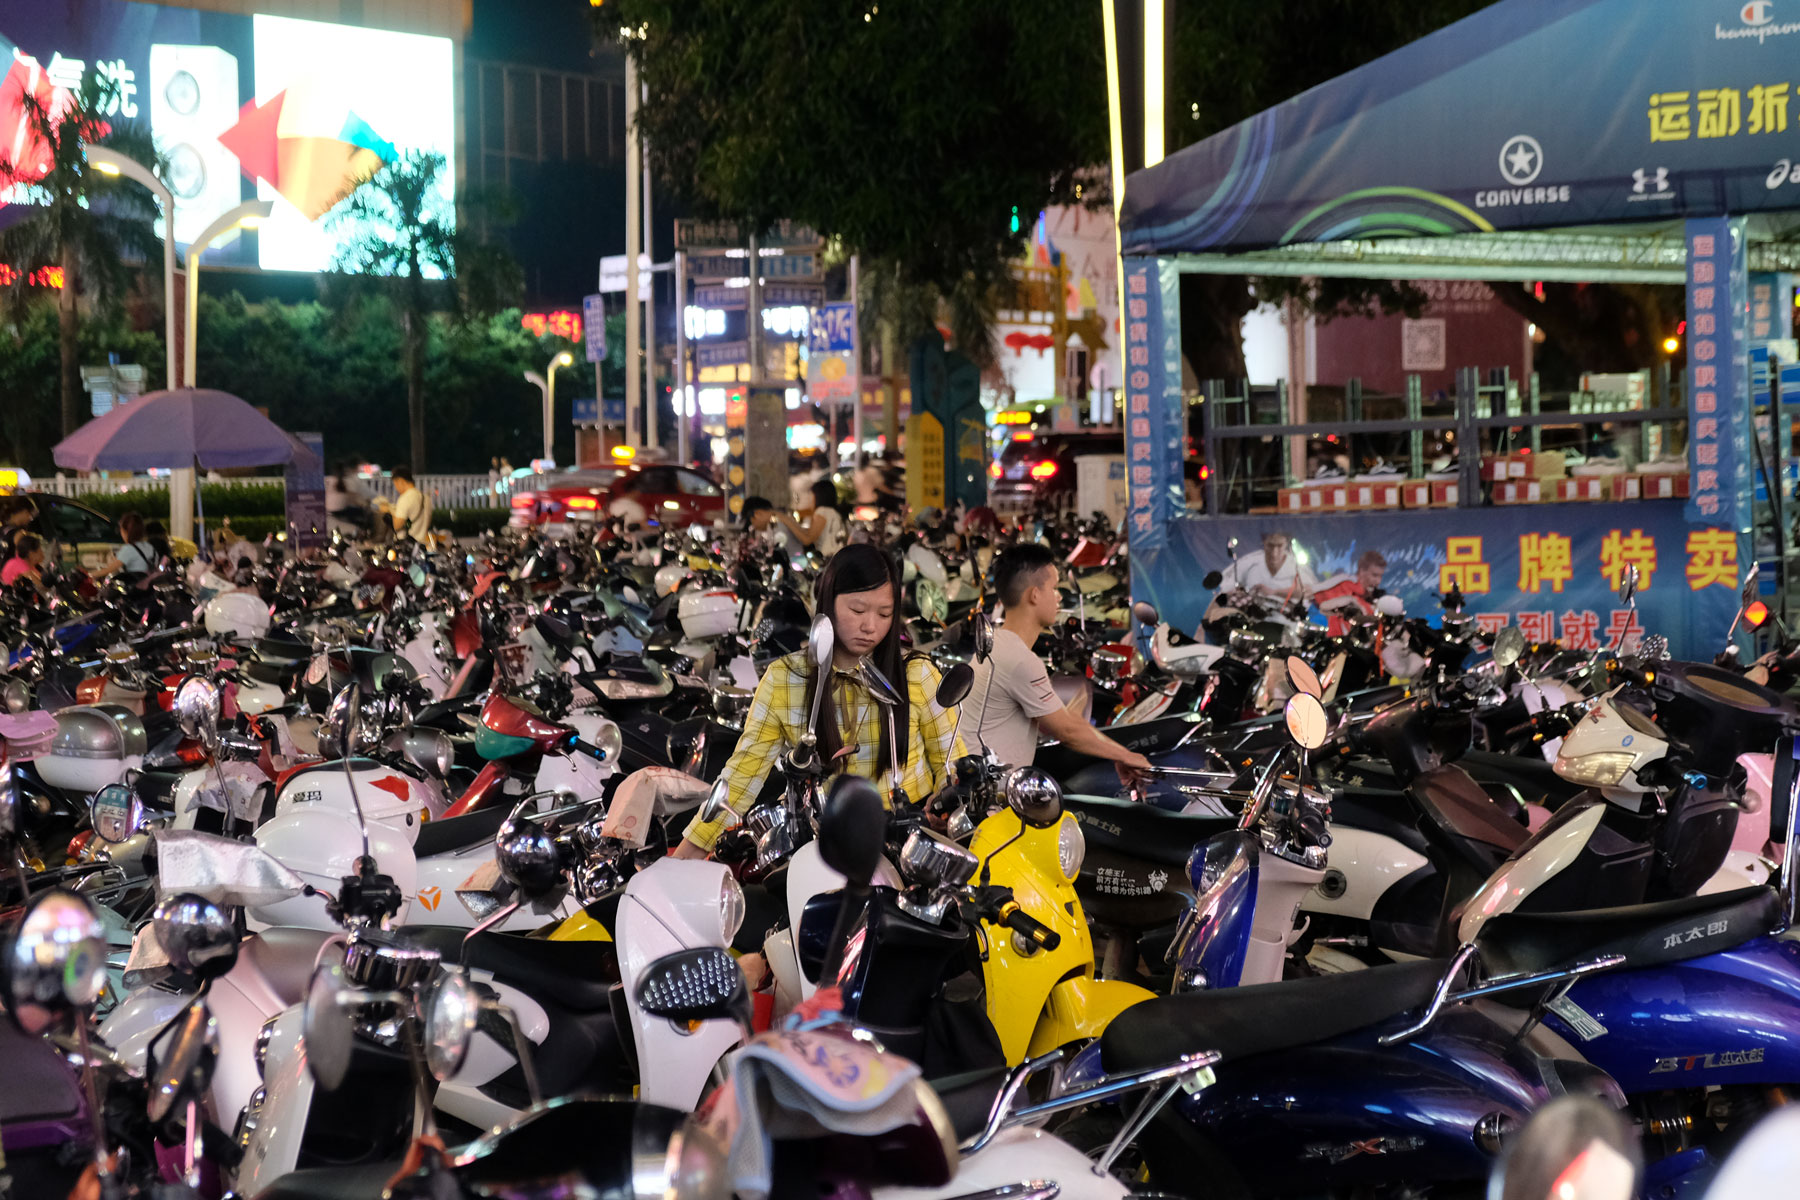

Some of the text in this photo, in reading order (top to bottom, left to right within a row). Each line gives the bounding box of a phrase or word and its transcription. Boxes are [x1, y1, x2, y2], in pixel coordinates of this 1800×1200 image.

[1648, 82, 1800, 143] 运动折
[1475, 186, 1570, 208] CONVERSE
[1440, 527, 1740, 594] 品牌特卖
[1663, 920, 1729, 949] 本太郎
